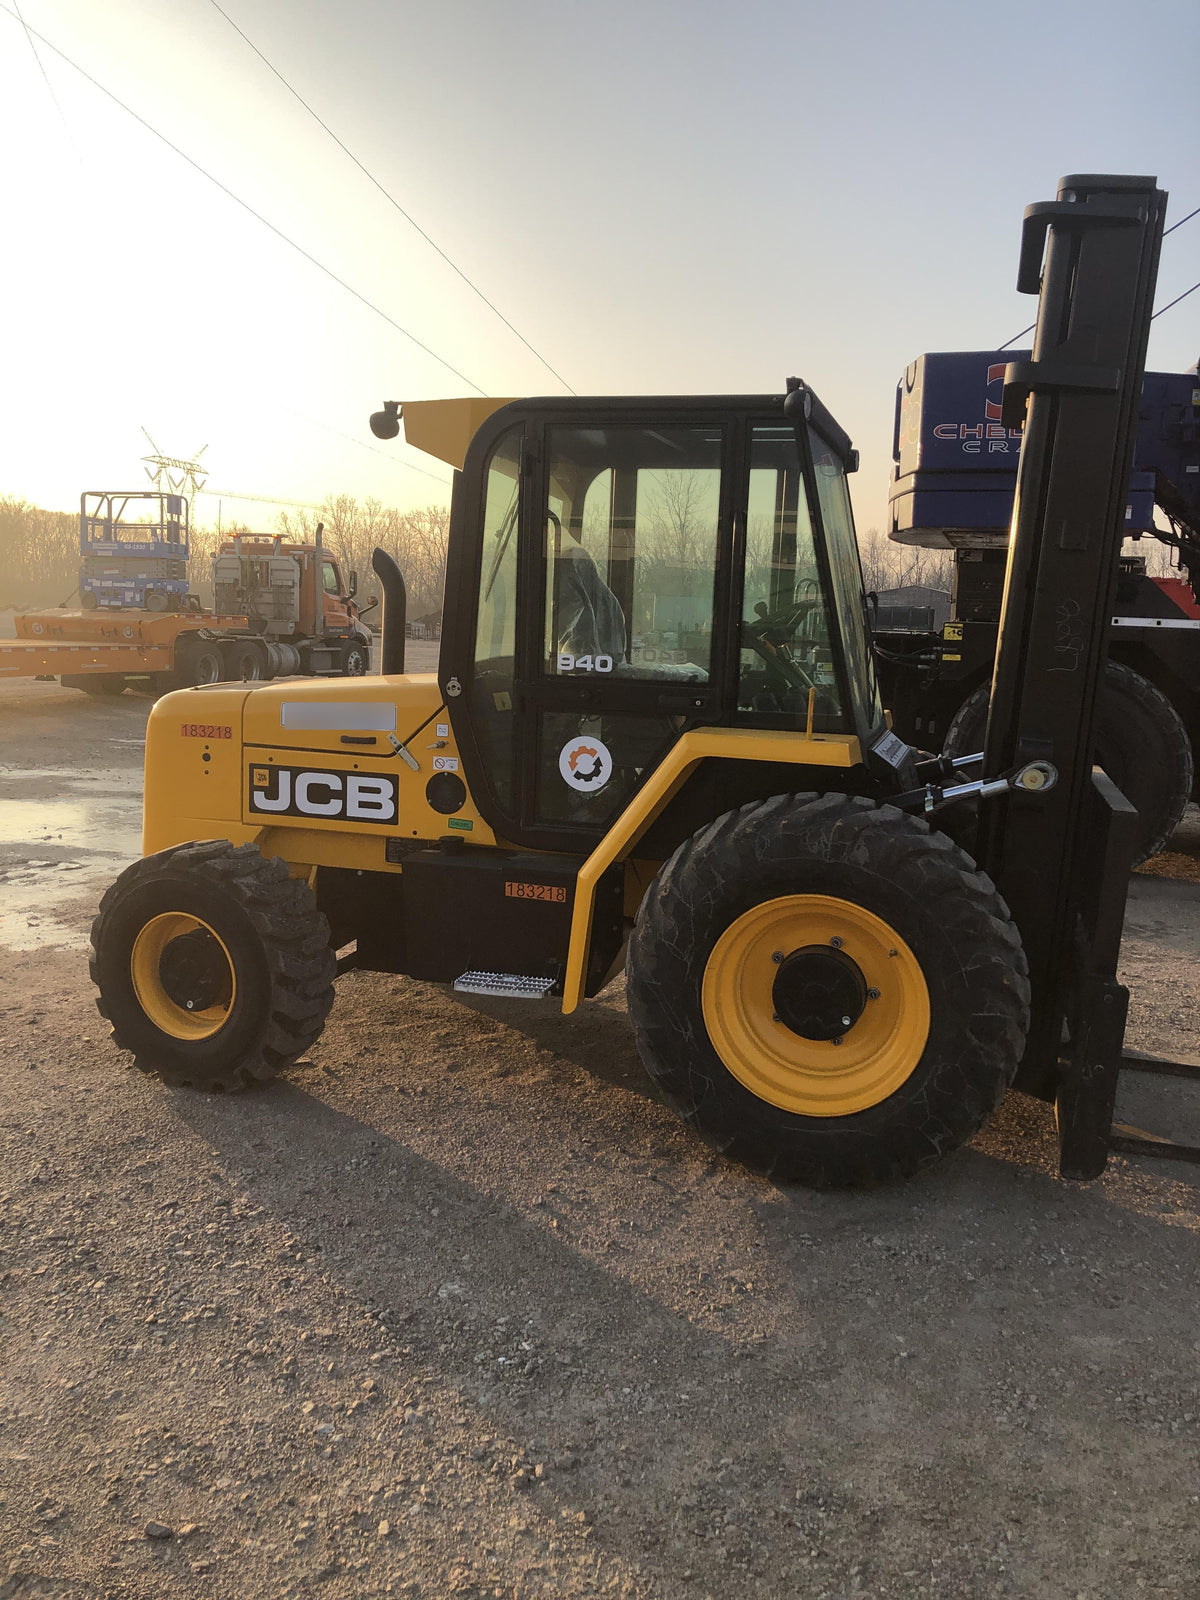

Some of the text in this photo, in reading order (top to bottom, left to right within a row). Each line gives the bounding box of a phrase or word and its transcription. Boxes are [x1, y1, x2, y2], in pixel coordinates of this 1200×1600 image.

[557, 653, 612, 673] 940
[182, 724, 232, 739] 183218
[253, 770, 396, 820] JCB
[507, 882, 565, 901] 183218
